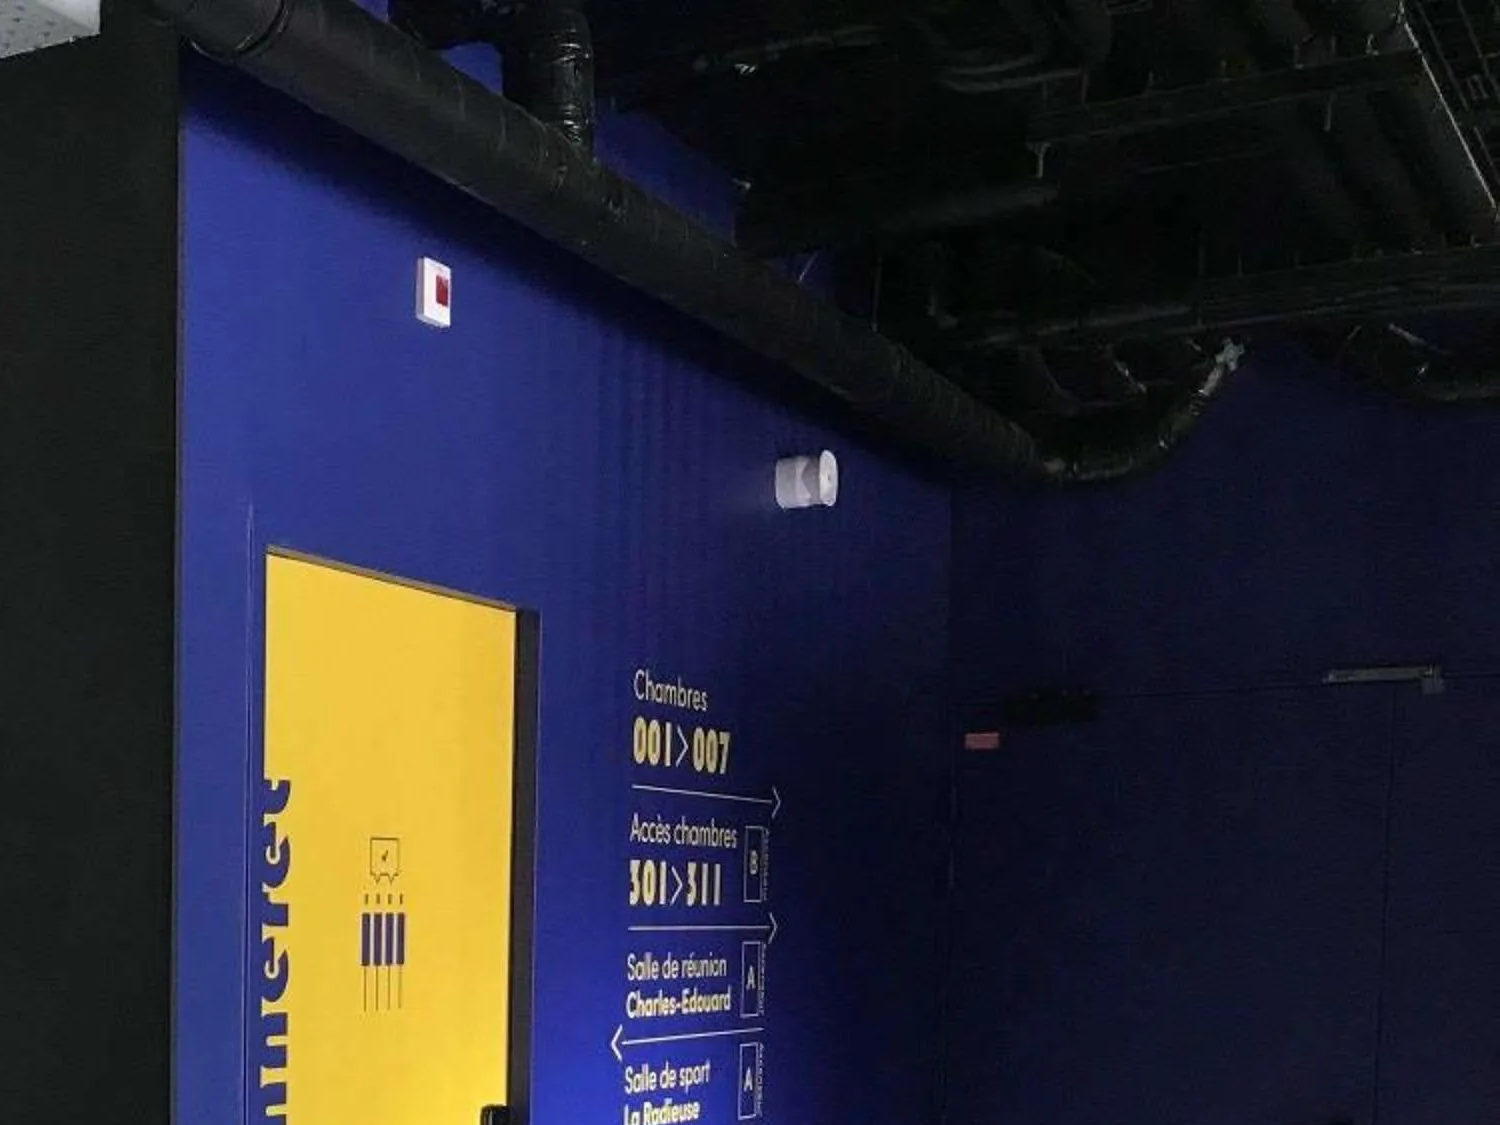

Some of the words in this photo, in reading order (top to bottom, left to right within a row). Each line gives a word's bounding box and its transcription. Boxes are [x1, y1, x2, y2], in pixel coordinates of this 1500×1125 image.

[634, 668, 708, 712] Chambres
[629, 811, 671, 845] Accès
[673, 815, 737, 849] chambres
[749, 849, 759, 875] B
[627, 952, 659, 981] Salle
[662, 952, 680, 979] de
[681, 951, 727, 979] réunion
[745, 964, 756, 991] A
[626, 984, 732, 1019] Charles-Edouard
[624, 1062, 657, 1095] Salle
[659, 1059, 677, 1089] de
[679, 1057, 711, 1094] sport
[743, 1066, 753, 1093] A
